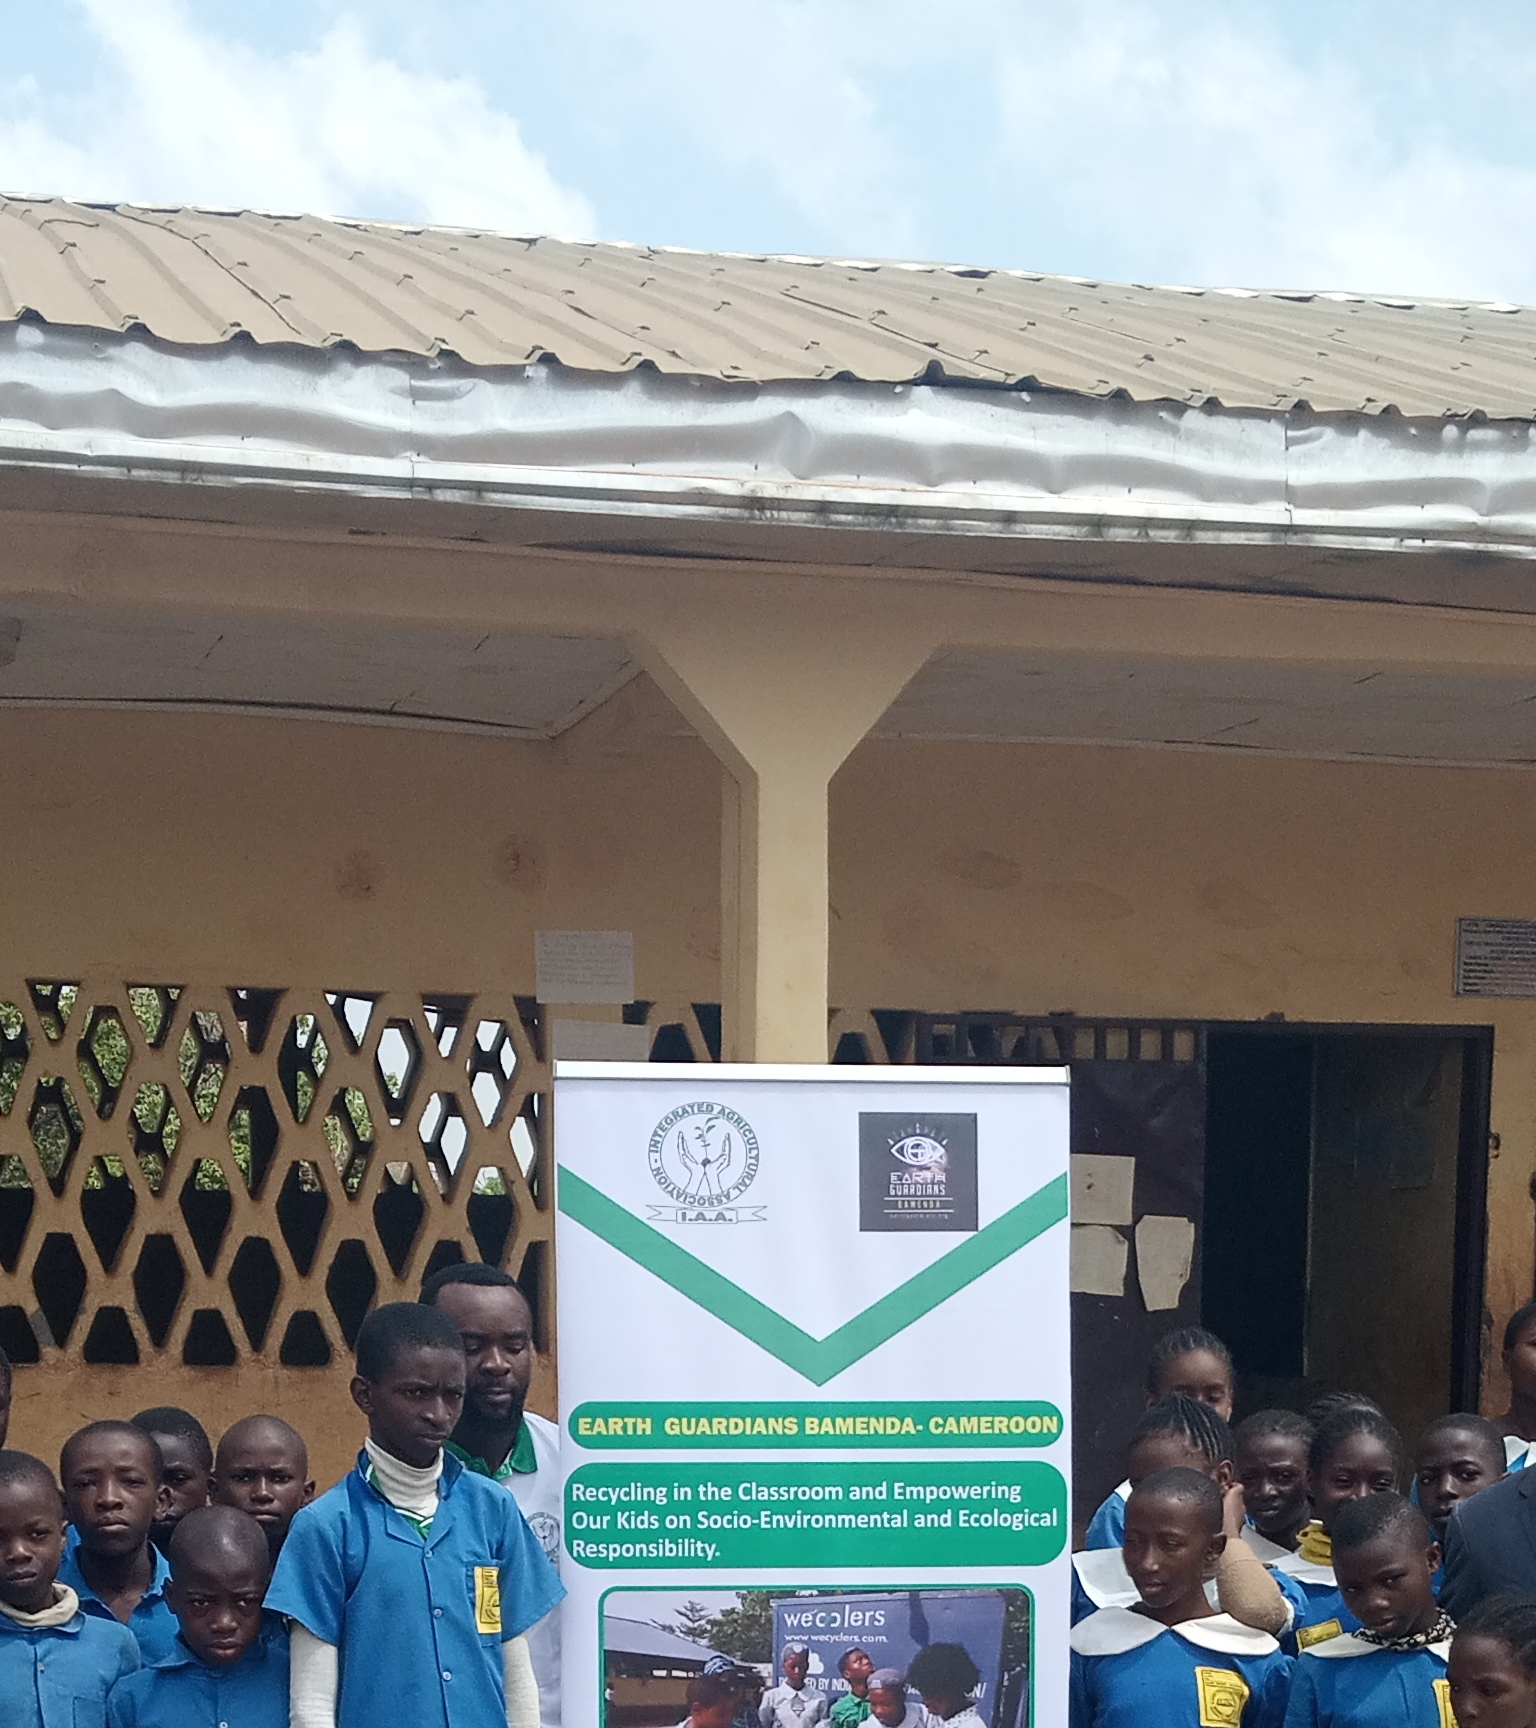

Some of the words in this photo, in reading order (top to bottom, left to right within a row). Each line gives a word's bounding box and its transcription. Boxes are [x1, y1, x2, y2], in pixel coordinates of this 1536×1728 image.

[649, 1103, 714, 1153] INTEGRATED
[717, 1105, 759, 1193] AGRICULTURAL
[652, 1166, 731, 1206] ASSOCIATION
[890, 1172, 946, 1183] EARTH
[889, 1184, 946, 1196] GUARDIANS
[681, 1211, 733, 1222] I.A.A.
[578, 1417, 652, 1435] EARTH
[664, 1417, 798, 1435] GUARDIANS
[929, 1416, 1058, 1434] CAMEROON
[572, 1482, 667, 1505] Recycling
[673, 1482, 692, 1501] in
[698, 1482, 732, 1501] the
[738, 1481, 843, 1501] Classroom
[849, 1481, 887, 1500] and
[893, 1481, 1021, 1503] Empowering
[571, 1511, 610, 1529] Our
[617, 1510, 659, 1529] Kids
[665, 1515, 691, 1529] on
[697, 1509, 908, 1529] Socio-Environmental
[914, 1508, 952, 1528] and
[958, 1508, 1057, 1530] Ecological
[572, 1538, 720, 1561] Responsibility.
